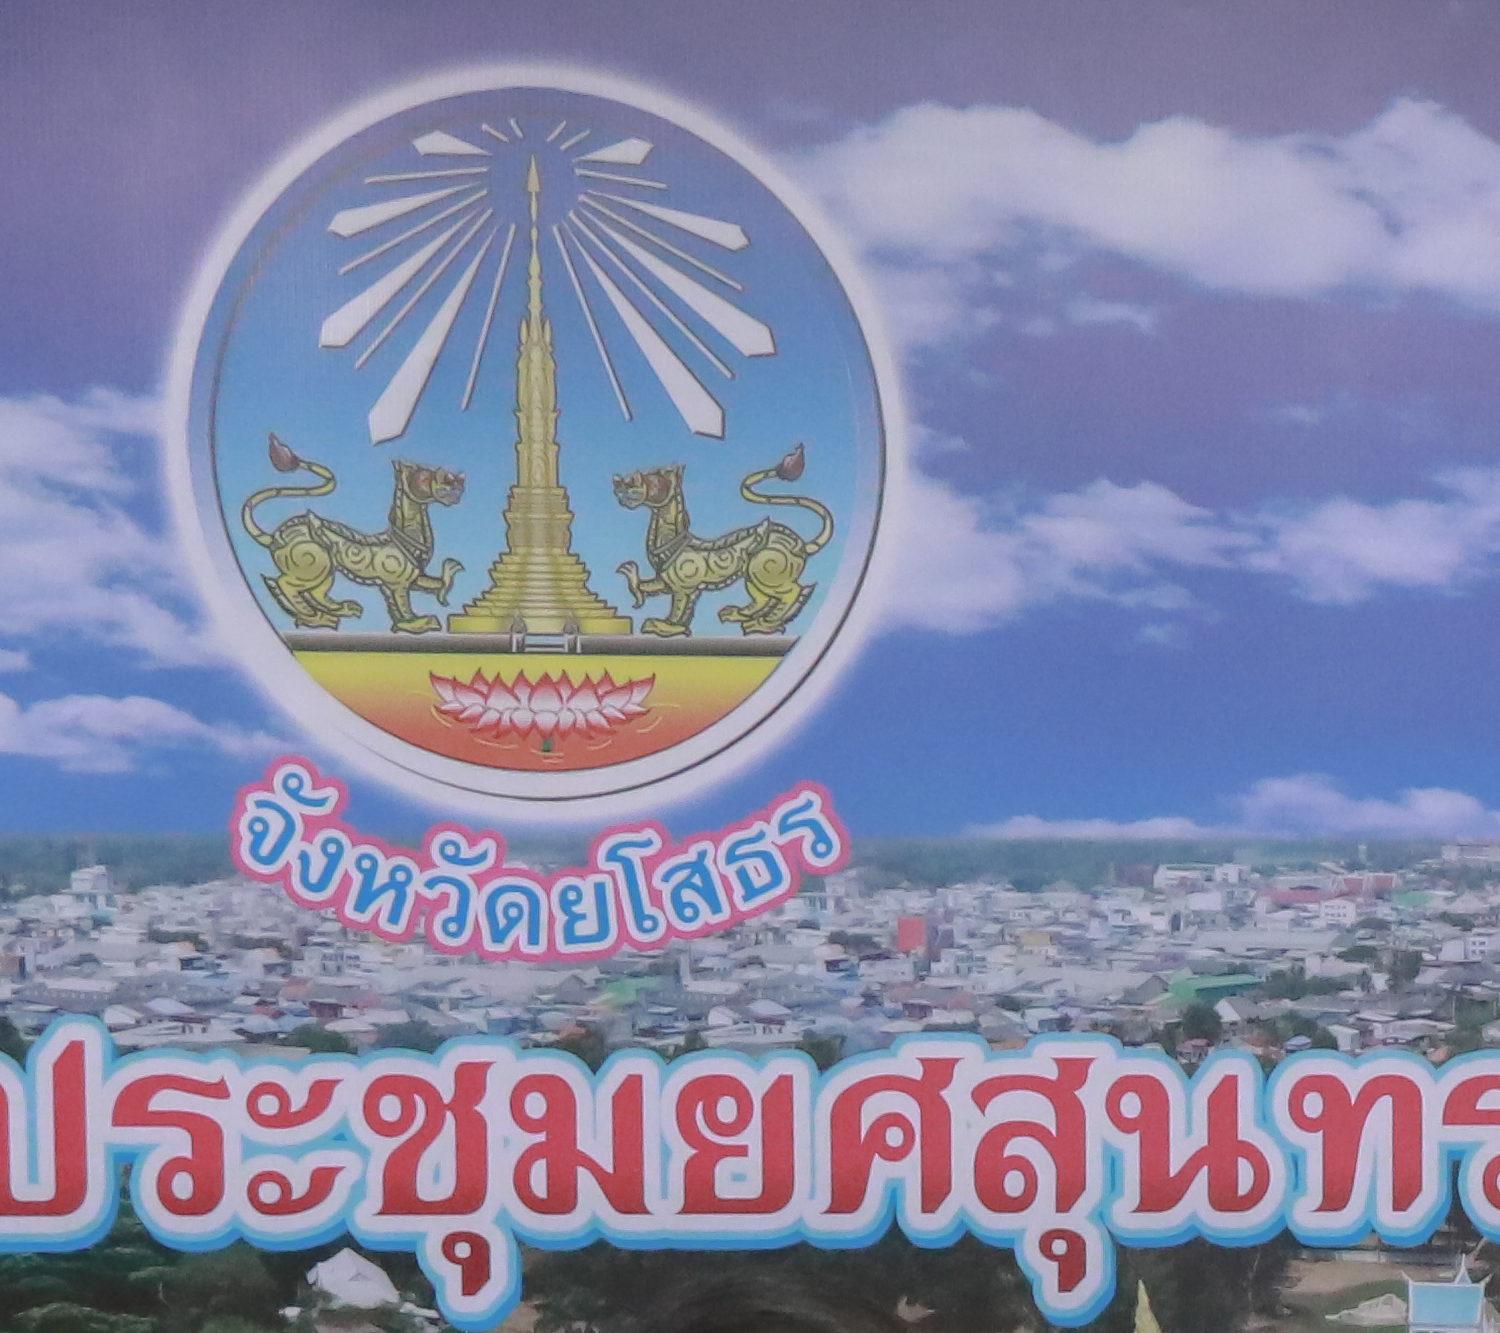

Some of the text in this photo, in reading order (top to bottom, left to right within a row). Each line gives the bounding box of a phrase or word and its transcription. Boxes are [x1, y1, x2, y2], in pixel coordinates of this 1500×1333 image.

[244, 769, 838, 948] จังหวัดยโสธร
